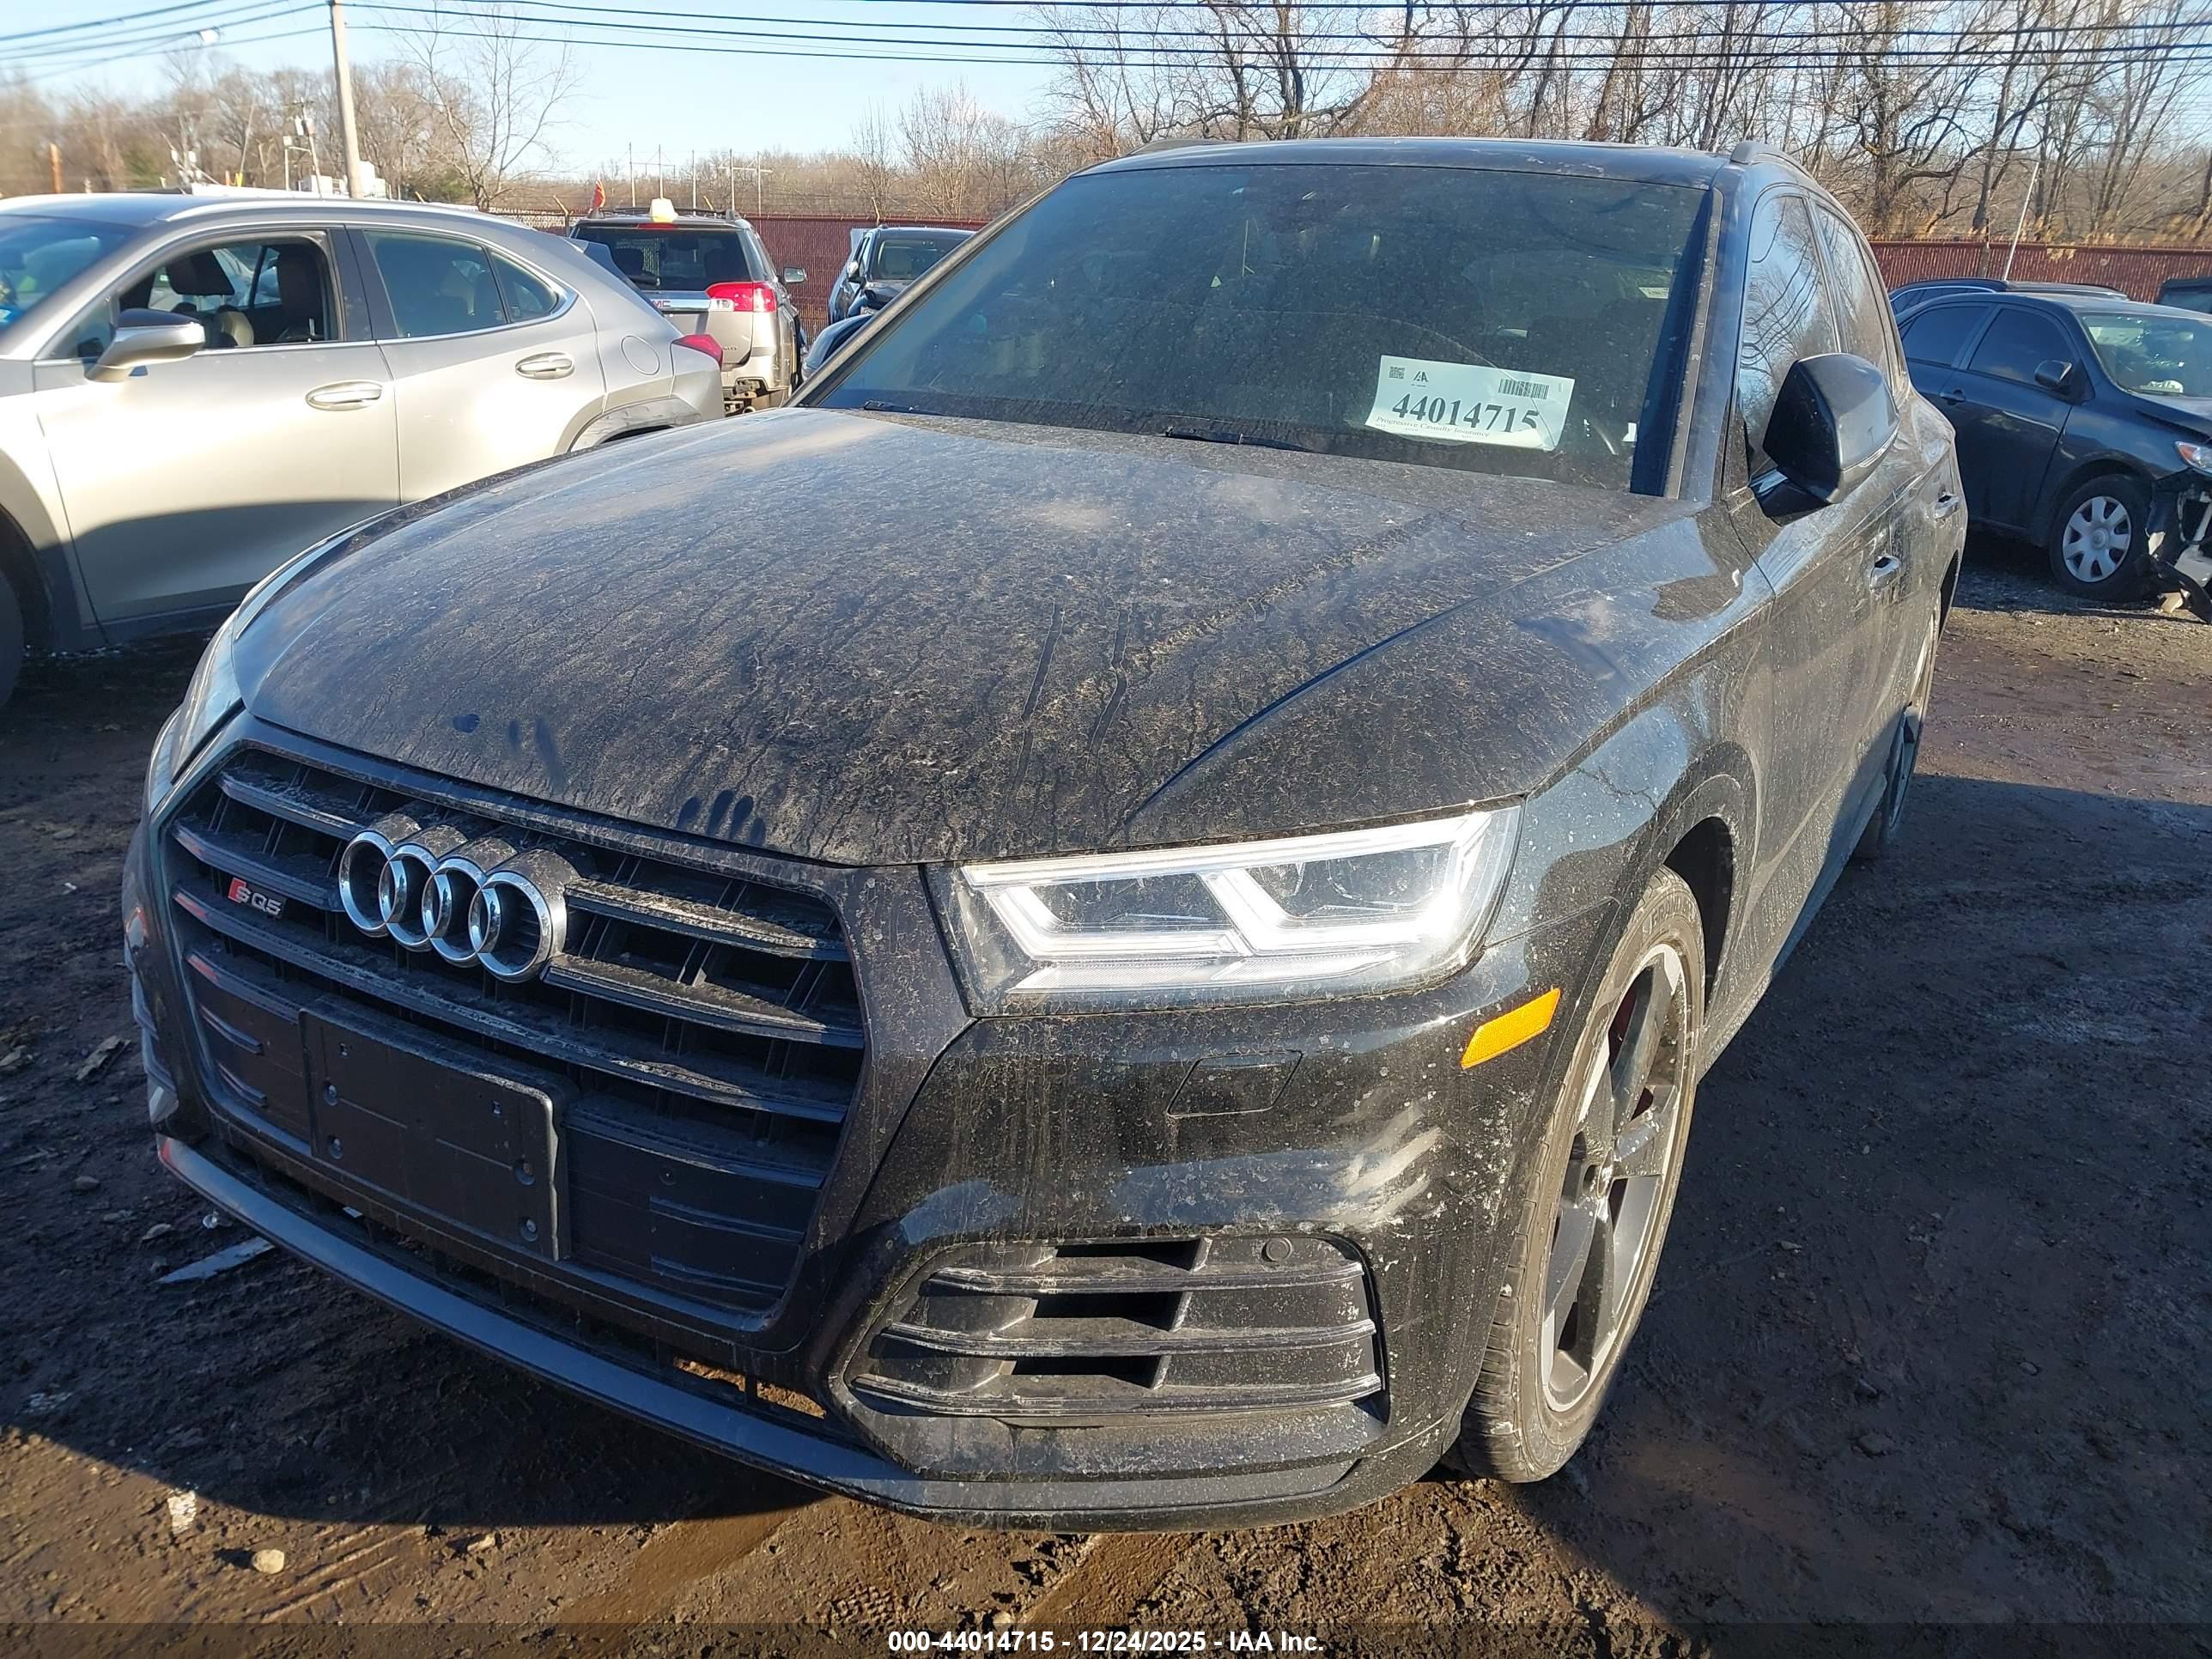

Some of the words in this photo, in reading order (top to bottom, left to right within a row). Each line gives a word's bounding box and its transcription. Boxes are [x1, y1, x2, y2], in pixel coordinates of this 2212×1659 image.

[1376, 416, 1419, 428] Progressive
[1419, 423, 1453, 434] Casualty
[1454, 428, 1491, 437] Insurance
[1391, 393, 1540, 433] 44014715
[235, 884, 283, 916] SQ5
